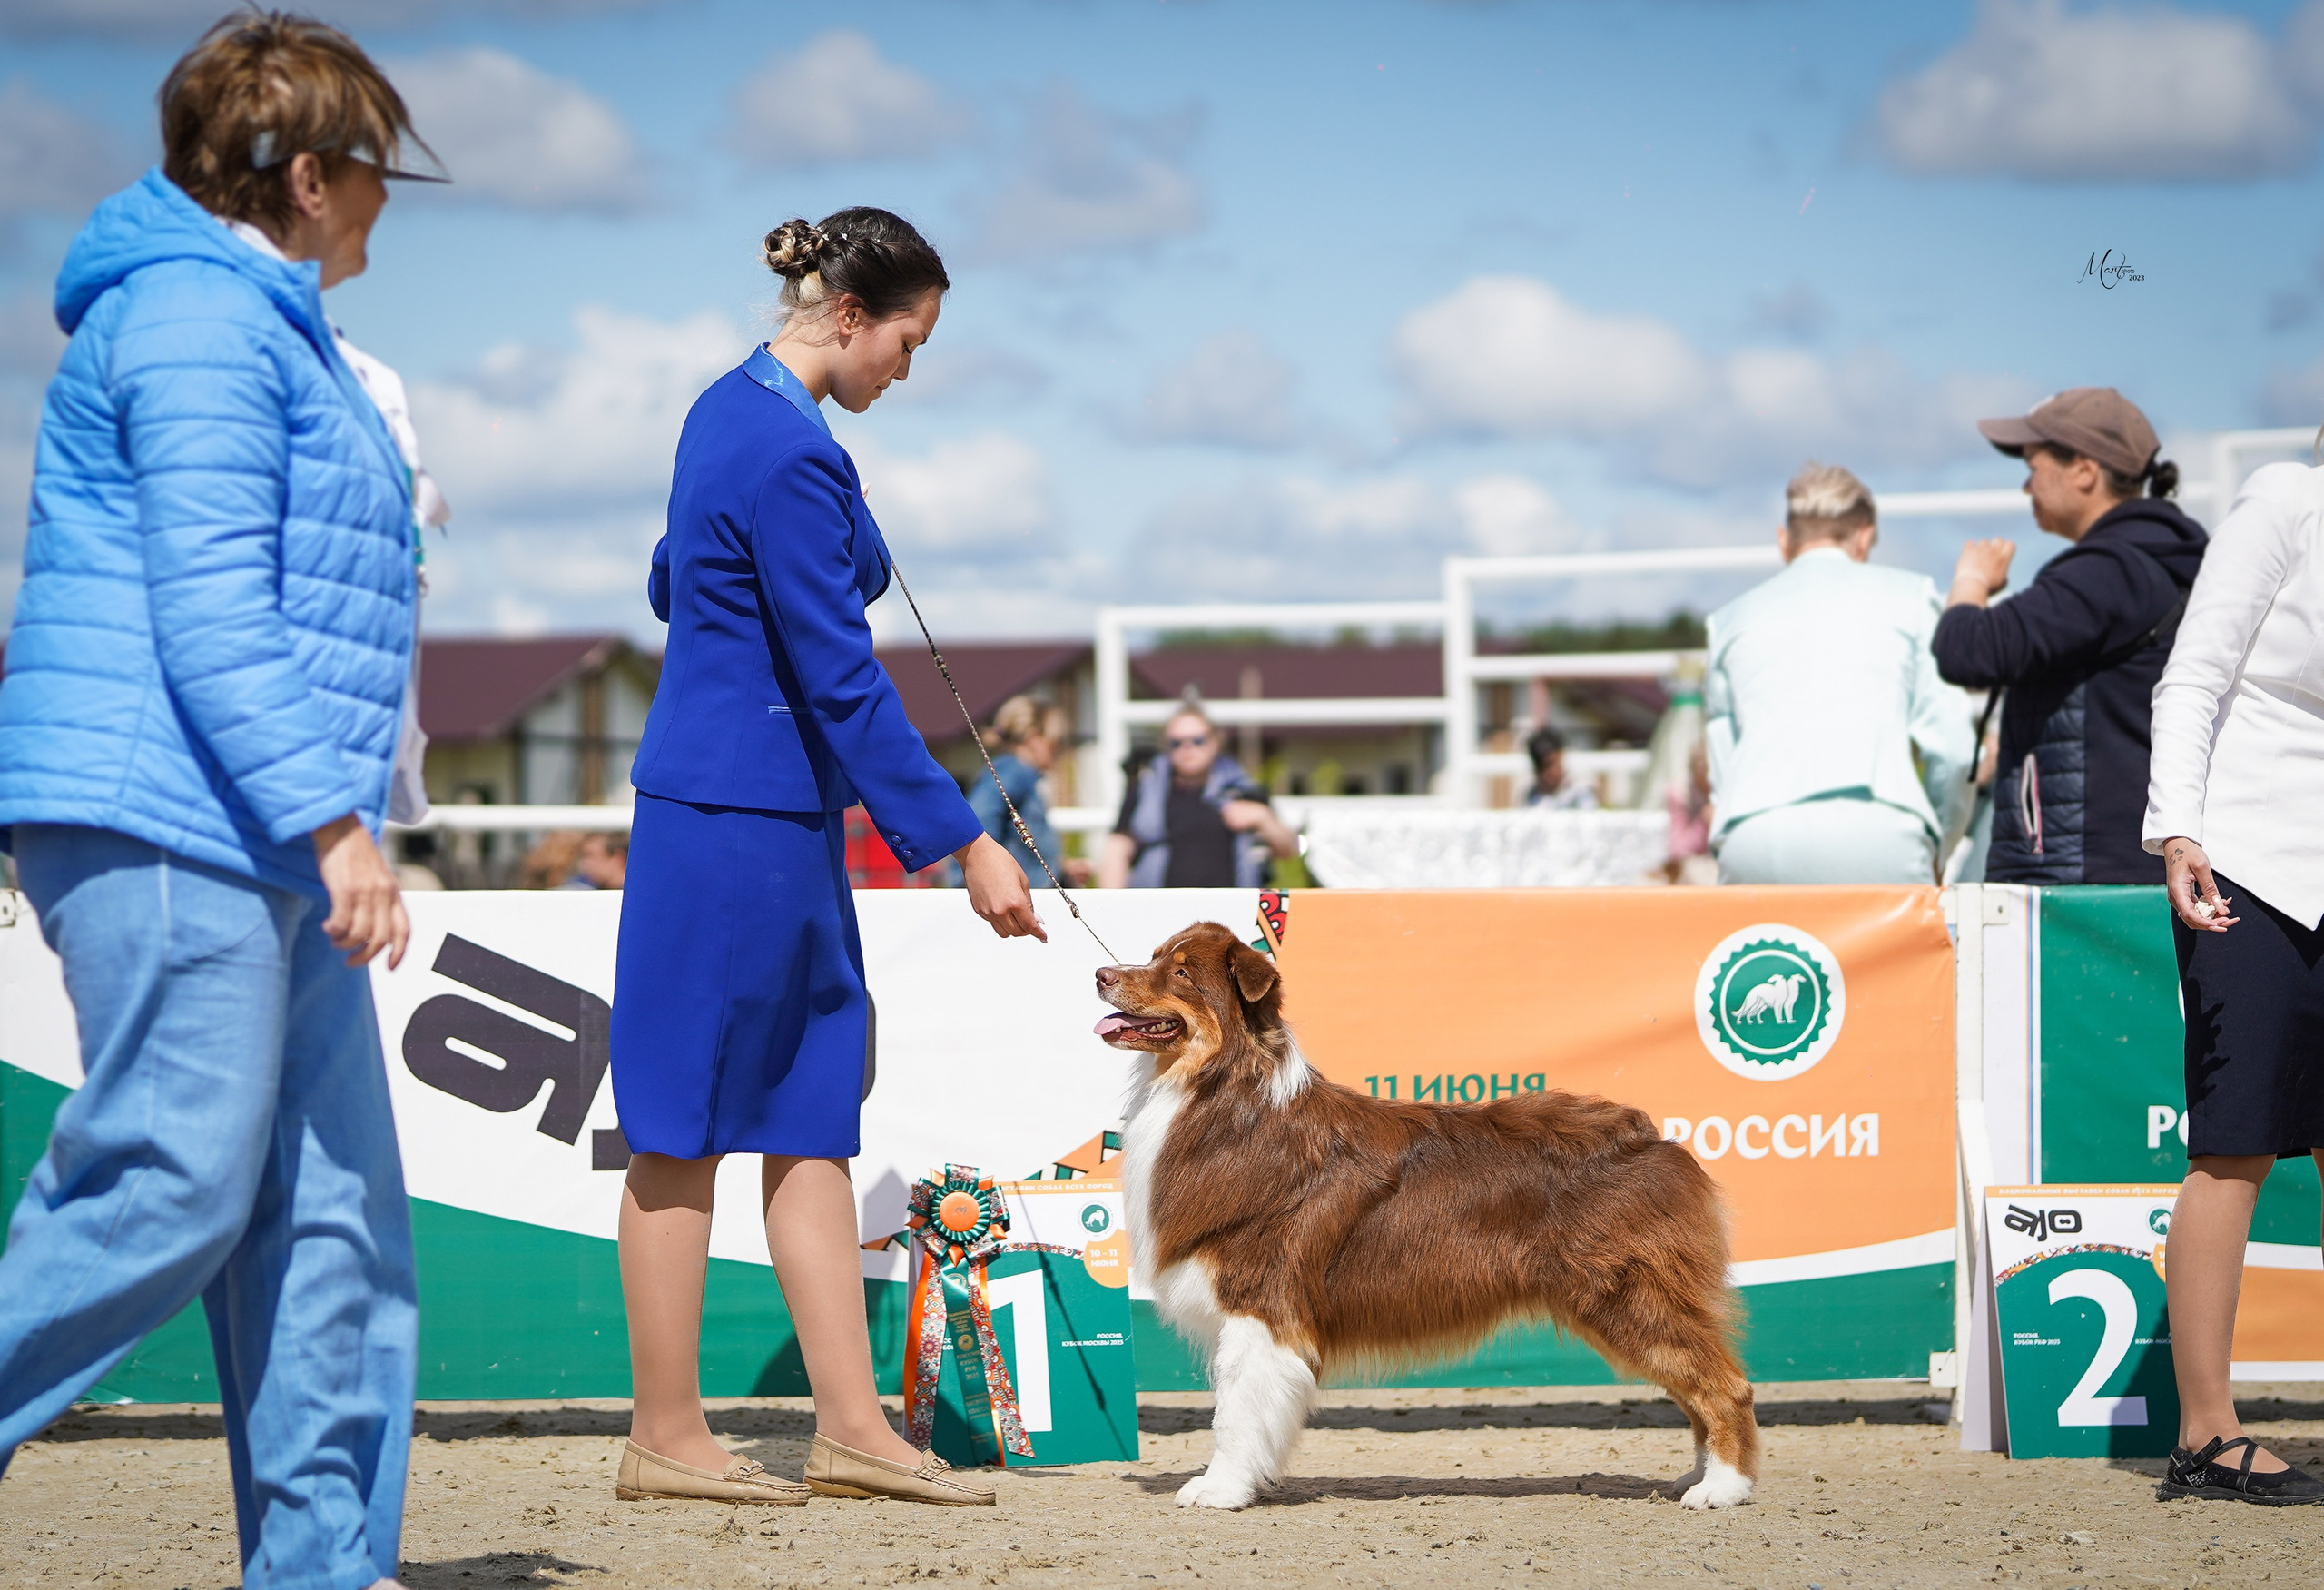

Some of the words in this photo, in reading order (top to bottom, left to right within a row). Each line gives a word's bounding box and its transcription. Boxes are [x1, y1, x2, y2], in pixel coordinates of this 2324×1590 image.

[1364, 1074, 1398, 1101] 11
[1413, 1072, 1546, 1103] ИЮНЯ
[1662, 1112, 1879, 1160] РОССИЯ
[1090, 1249, 1102, 1258] 10
[1109, 1249, 1118, 1257] 11
[1090, 1259, 1118, 1268] ИЮНЯ
[988, 1269, 1053, 1433] 1
[2048, 1269, 2149, 1427] 2
